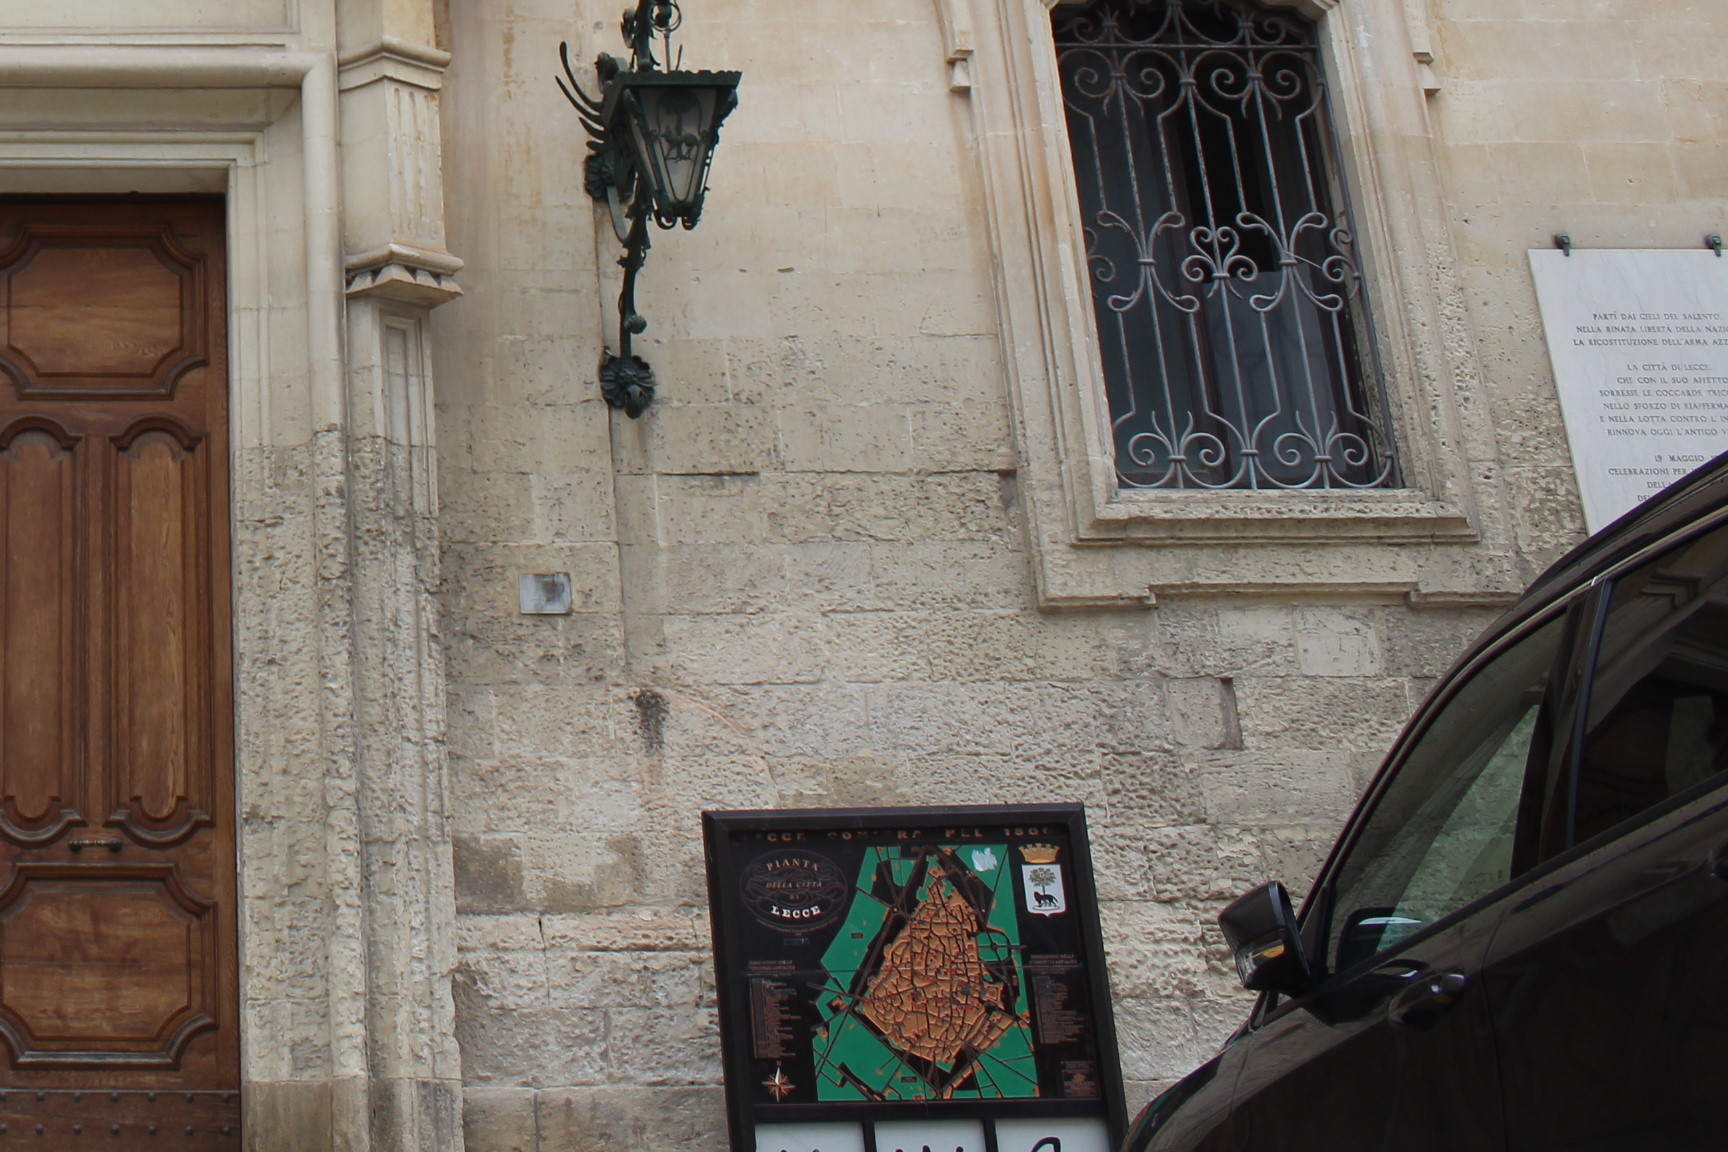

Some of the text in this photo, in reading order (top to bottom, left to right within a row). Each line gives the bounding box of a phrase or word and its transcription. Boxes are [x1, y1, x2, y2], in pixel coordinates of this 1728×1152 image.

[1640, 323, 1673, 333] LIBERTÀ
[1573, 338, 1585, 346] LA
[1662, 338, 1708, 346] DELL'ARMA
[1627, 363, 1639, 371] LA
[1642, 361, 1668, 371] CITTÀ
[1599, 389, 1639, 397] SORRESSE
[1642, 389, 1652, 397] LE
[1656, 389, 1703, 397] COCCARDE
[1603, 402, 1630, 410] NELLO
[1633, 402, 1667, 410] SFORZO
[1671, 402, 1681, 410] DI
[1599, 415, 1605, 423] E
[1608, 415, 1635, 423] NELLA
[1638, 415, 1667, 423] LOTTA
[1670, 415, 1707, 423] CONTRO
[1607, 428, 1648, 436] RINNOVA
[1650, 428, 1673, 436] OGGI
[1677, 428, 1718, 436] L'ANTICO
[1608, 468, 1670, 476] CELEBRAZIONI
[766, 858, 821, 872] PIANTA
[771, 905, 821, 919] LECCE
